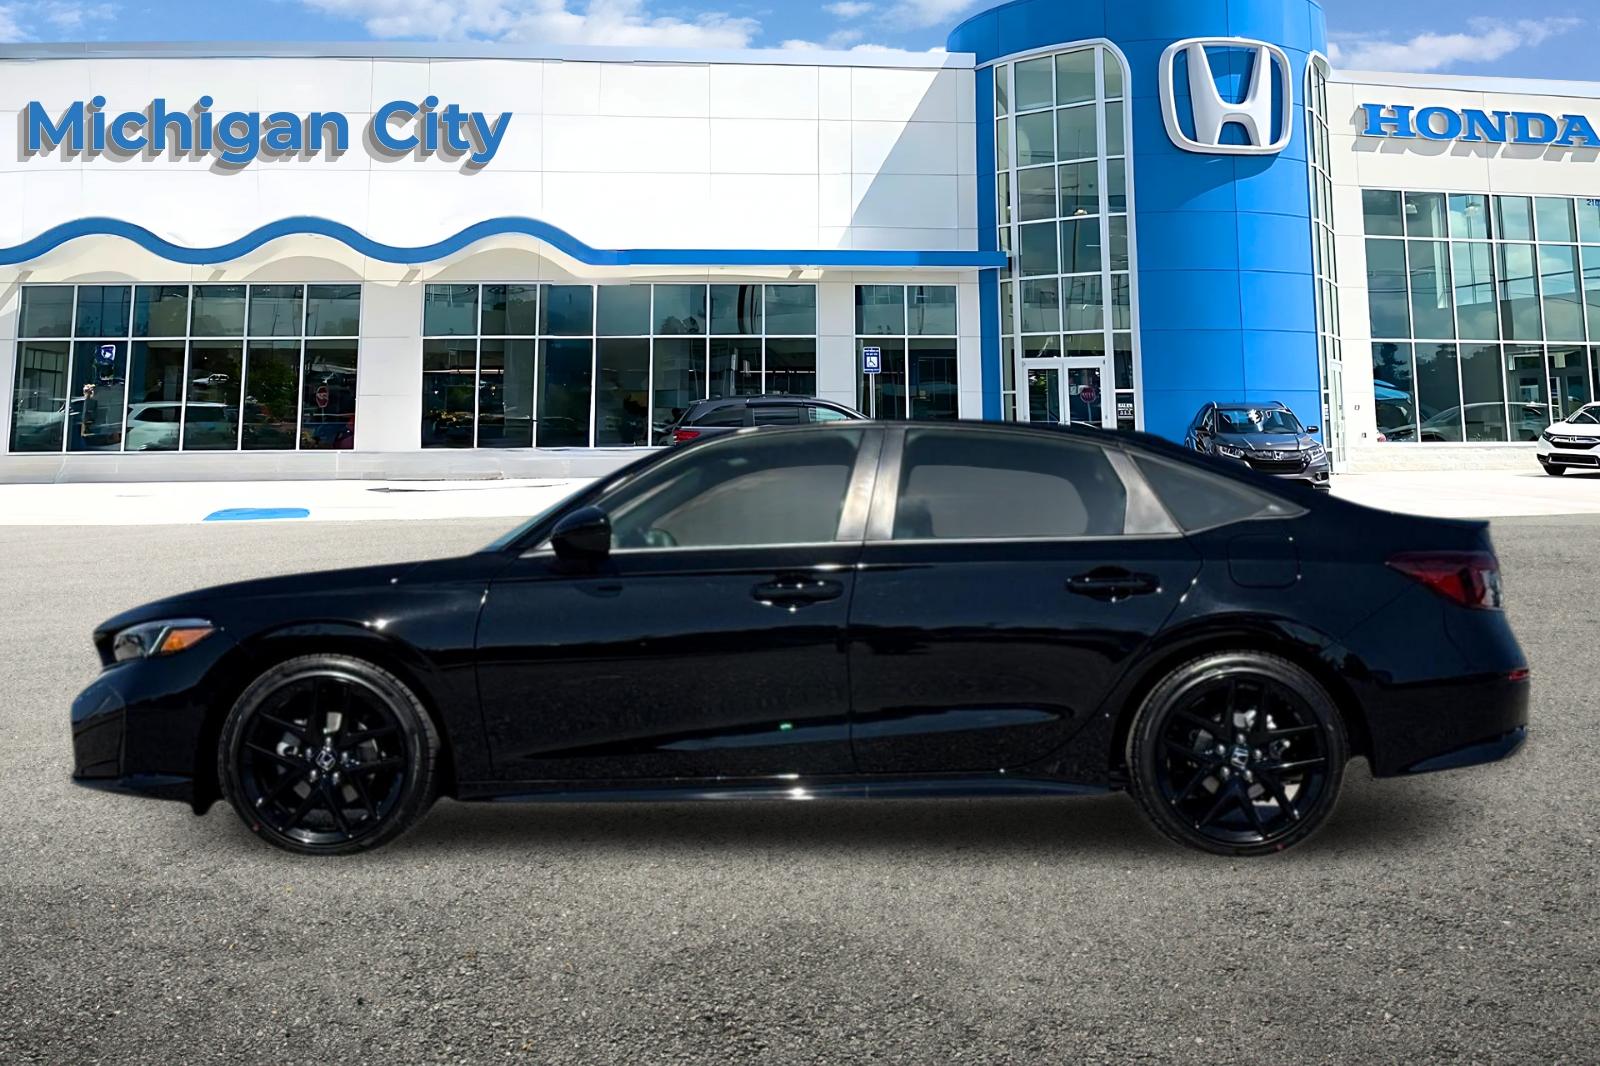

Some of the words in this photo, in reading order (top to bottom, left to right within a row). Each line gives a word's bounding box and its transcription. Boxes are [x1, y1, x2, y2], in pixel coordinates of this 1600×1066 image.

[28, 95, 349, 163] Michigan
[374, 95, 513, 164] City
[1361, 103, 1600, 147] HONDA
